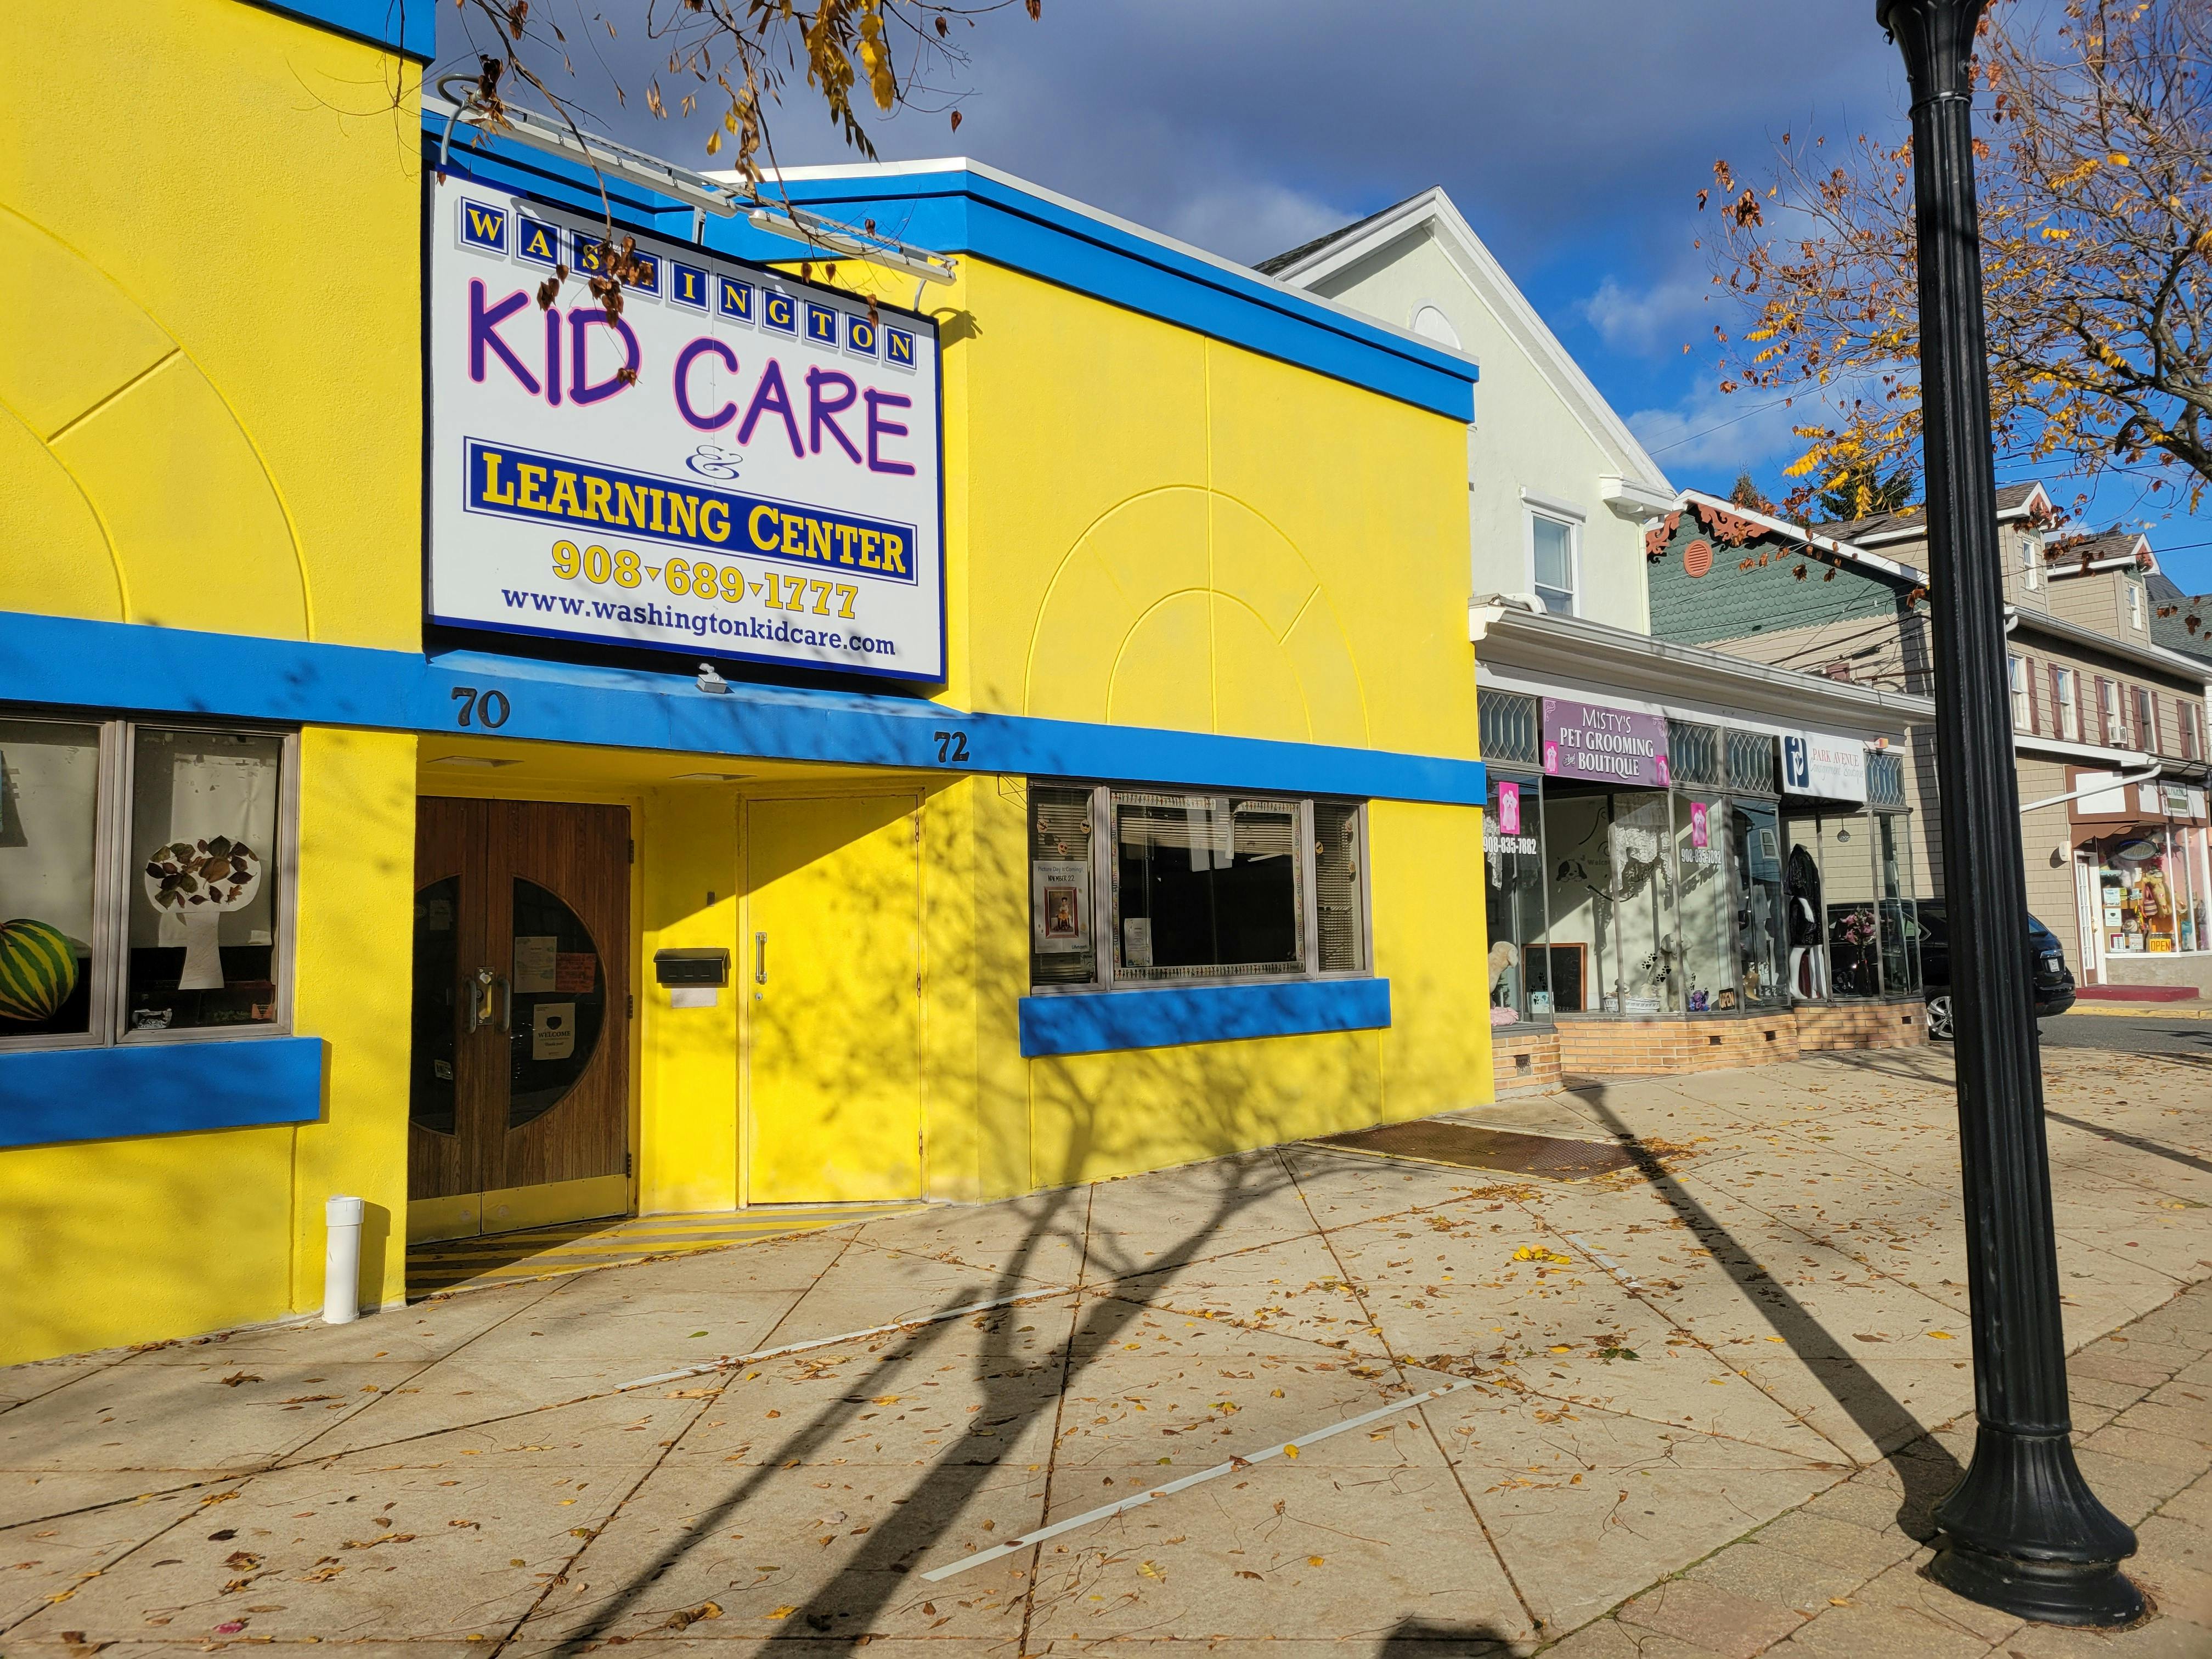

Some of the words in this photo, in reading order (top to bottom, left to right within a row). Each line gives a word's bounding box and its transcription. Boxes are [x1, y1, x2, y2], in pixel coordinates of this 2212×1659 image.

[466, 207, 911, 361] WASINGTON
[468, 277, 642, 408] KID
[673, 336, 918, 476] CARE
[686, 445, 743, 479] &
[482, 452, 731, 543] LEARNING
[748, 505, 906, 574] CENTER
[501, 589, 896, 656] www.washingtonkidcare.com
[451, 686, 511, 729] 70
[934, 731, 970, 763] 72
[1560, 727, 1582, 748] PET
[1585, 731, 1654, 758] GROOMING
[1813, 748, 1831, 763] PARK
[1833, 752, 1859, 767] AVENUE
[1564, 753, 1576, 766] And
[1578, 752, 1640, 779] BOUTIQUE
[1809, 758, 1841, 781] Consignment
[1843, 763, 1864, 786] Boutique
[1483, 836, 1537, 855] 908-835-7882
[1681, 848, 1722, 864] 908-835-7882
[2151, 941, 2170, 951] OPEN
[1719, 991, 1735, 1008] OPEN
